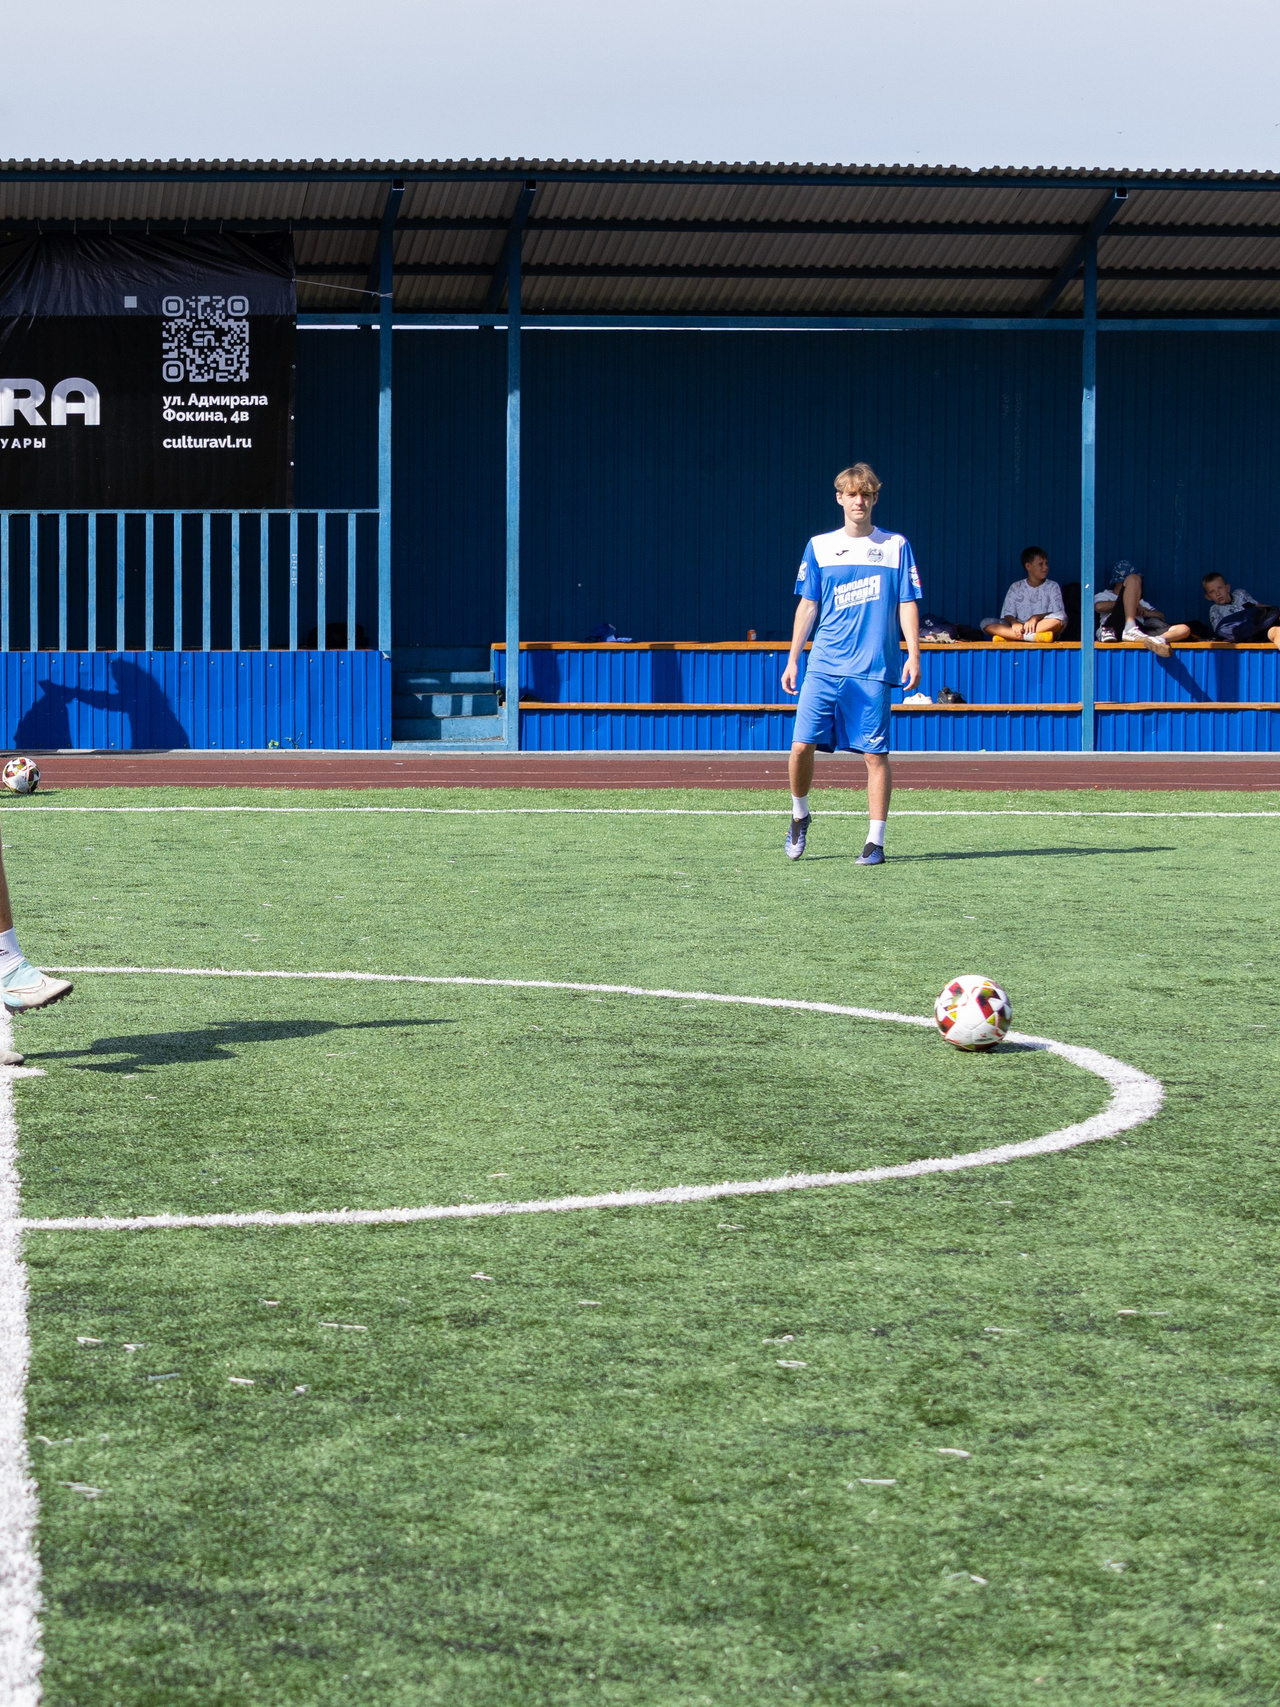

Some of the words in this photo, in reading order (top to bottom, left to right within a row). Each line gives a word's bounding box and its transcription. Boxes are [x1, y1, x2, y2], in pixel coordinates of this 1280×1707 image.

[162, 395, 185, 409] ул.
[187, 393, 268, 409] Адмирала
[162, 408, 228, 424] Фокина,
[162, 435, 252, 449] culturavl.ru
